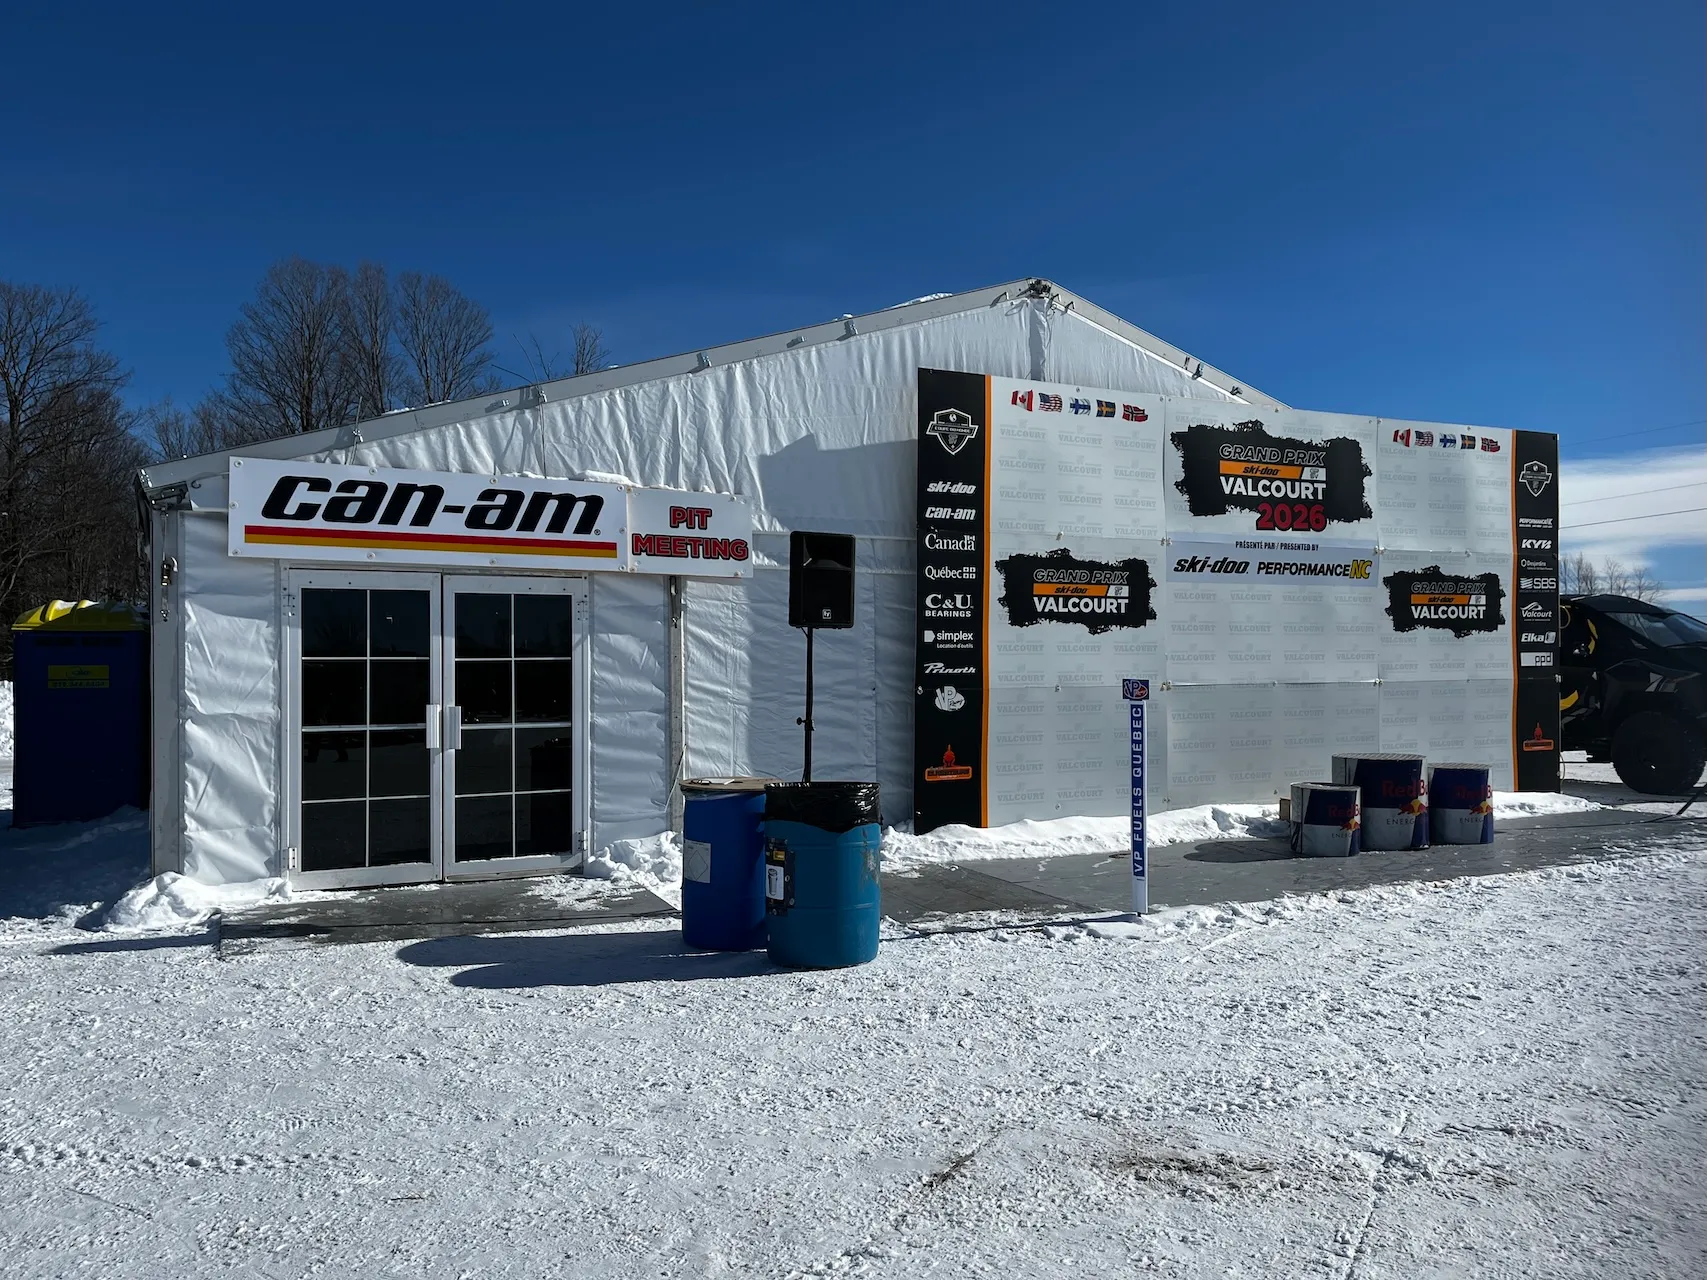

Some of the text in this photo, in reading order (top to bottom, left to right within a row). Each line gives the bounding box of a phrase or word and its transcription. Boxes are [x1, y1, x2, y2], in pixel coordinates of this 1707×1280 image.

[1000, 428, 1046, 439] VALCOURT
[1058, 434, 1103, 445] VALCOURT
[1114, 440, 1157, 450] VALCOURT
[1219, 443, 1326, 466] GRAND PRIX
[999, 459, 1046, 470] VALCOURT
[1058, 464, 1102, 475] VALCOURT
[1114, 469, 1157, 479] VALCOURT
[1242, 465, 1280, 476] ski-doo
[927, 481, 976, 494] ski-doo
[1219, 476, 1327, 500] VALCOURT
[1000, 490, 1047, 500] VALCOURT
[1058, 494, 1103, 505] VALCOURT
[1114, 498, 1157, 508] VALCOURT
[925, 506, 976, 520] can-am
[1256, 502, 1328, 532] 2026
[669, 505, 712, 531] PIT
[998, 521, 1045, 531] VALCOURT
[1058, 525, 1103, 534] VALCOURT
[1114, 528, 1158, 537] VALCOURT
[925, 533, 975, 551] Canada
[1235, 540, 1263, 549] PRÉSENTÉ
[1264, 541, 1275, 550] PAR
[1280, 542, 1310, 551] PRESENTED
[1311, 543, 1319, 551] BY
[1521, 539, 1552, 549] KYB
[632, 533, 749, 562] MEETING
[1173, 556, 1250, 575] ski-doo
[925, 565, 962, 580] Québec
[1033, 568, 1129, 584] GRAND PRIX
[1411, 582, 1487, 594] GRAND PRIX
[1534, 578, 1556, 589] SBS
[1054, 586, 1088, 594] ski-doo
[1174, 592, 1216, 600] VALCOURT
[1230, 593, 1272, 601] VALCOURT
[1282, 594, 1323, 602] VALCOURT
[1033, 597, 1129, 613] VALCOURT
[1411, 605, 1487, 619] VALCOURT
[1522, 610, 1552, 618] Valcourt
[1171, 624, 1216, 632] VALCOURT
[1229, 624, 1271, 632] VALCOURT
[1284, 625, 1324, 633] VALCOURT
[1336, 625, 1374, 633] VALCOURT
[937, 630, 973, 642] simplex
[1521, 633, 1545, 643] Elka
[997, 644, 1044, 652] VALCOURT
[1056, 644, 1102, 652] VALCOURT
[1114, 644, 1158, 652] VALCOURT
[1284, 653, 1326, 661] VALCOURT
[998, 674, 1045, 682] VALCOURT
[1058, 674, 1103, 682] VALCOURT
[997, 705, 1044, 713] VALCOURT
[1056, 704, 1103, 712] VALCOURT
[1335, 708, 1375, 716] VALCOURT
[1171, 712, 1216, 720] VALCOURT
[1229, 710, 1272, 718] VALCOURT
[1283, 709, 1325, 717] VALCOURT
[996, 735, 1044, 743] VALCOURT
[1056, 733, 1102, 741] VALCOURT
[1335, 735, 1376, 743] VALCOURT
[1172, 741, 1216, 749] VALCOURT
[1230, 739, 1272, 747] VALCOURT
[996, 763, 1043, 772] VALCOURT
[1057, 761, 1103, 769] VALCOURT
[1172, 775, 1216, 783] VALCOURT
[1229, 772, 1272, 780] VALCOURT
[1382, 780, 1416, 797] Red
[997, 792, 1045, 801] VALCOURT
[1057, 790, 1104, 798] VALCOURT
[1133, 787, 1143, 842] FUELS
[1133, 850, 1143, 872] VP
